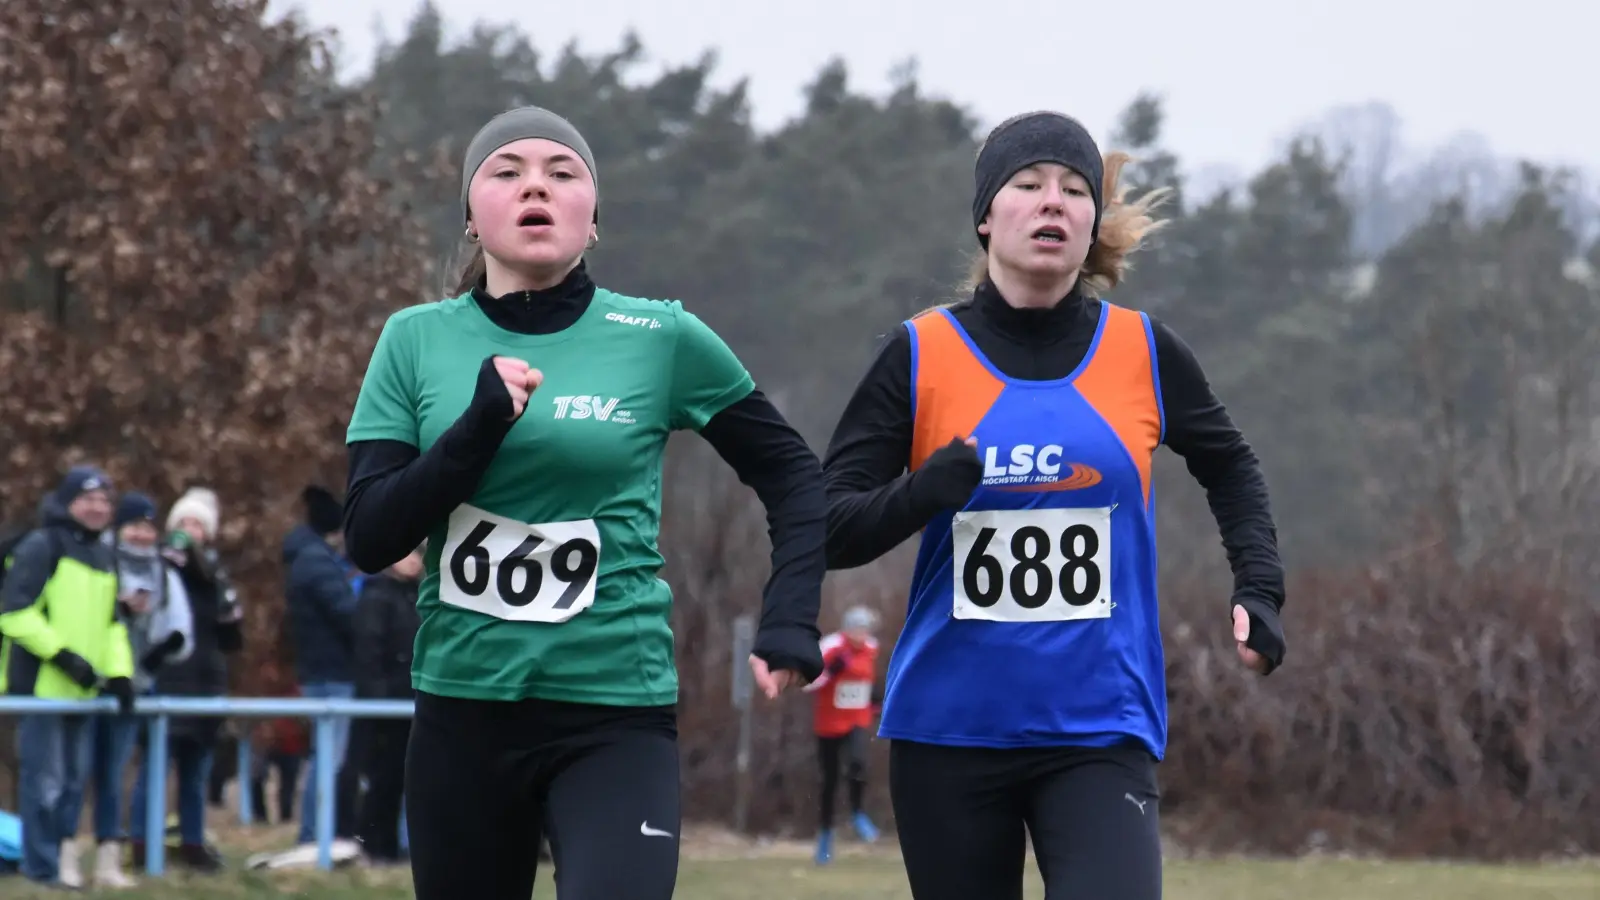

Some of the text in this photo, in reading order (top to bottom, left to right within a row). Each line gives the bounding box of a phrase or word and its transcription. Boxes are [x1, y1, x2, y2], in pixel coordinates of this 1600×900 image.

[605, 312, 650, 326] CRAFT
[552, 396, 620, 421] TSV
[984, 444, 1063, 477] LSC
[1035, 475, 1059, 483] AISCH
[450, 520, 598, 607] 669
